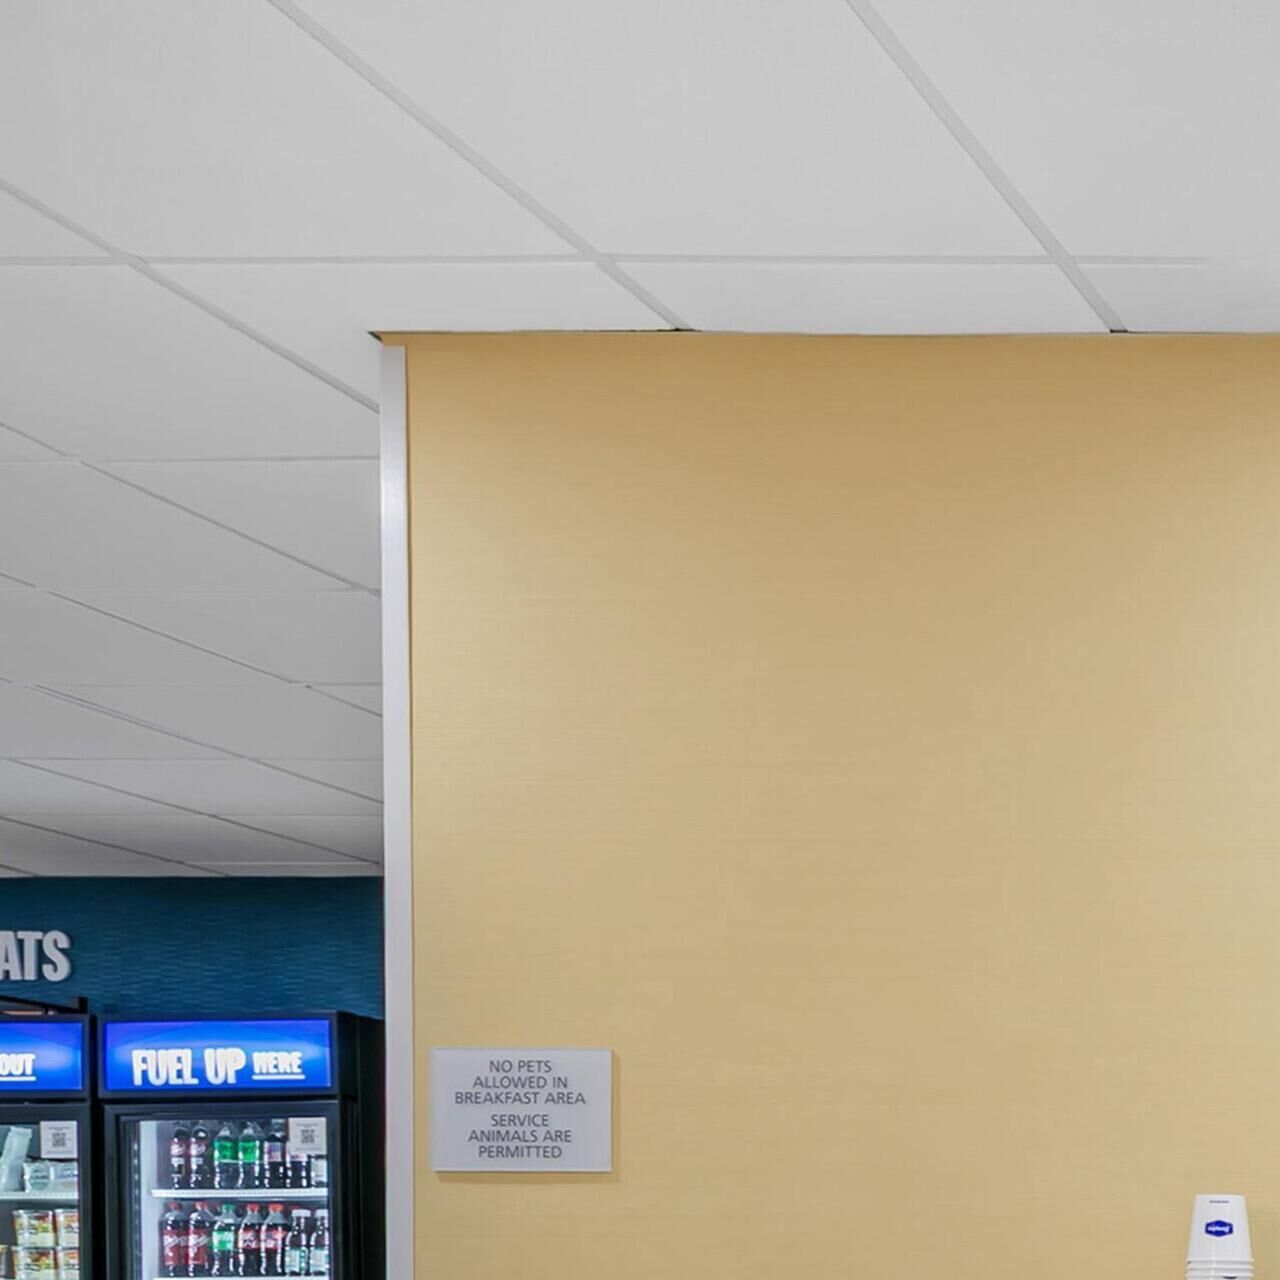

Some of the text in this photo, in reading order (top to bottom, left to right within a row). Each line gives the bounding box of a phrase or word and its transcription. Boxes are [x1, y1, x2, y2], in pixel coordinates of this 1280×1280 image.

[132, 1047, 303, 1086] FUEL UP HERE
[489, 1060, 552, 1073] NO PETS
[472, 1076, 568, 1089] ALLOWED IN
[455, 1091, 586, 1105] BREAKFAST AREA
[491, 1114, 549, 1127] SERVICE
[468, 1130, 572, 1143] ANIMALS ARE
[478, 1145, 563, 1159] PERMITTED
